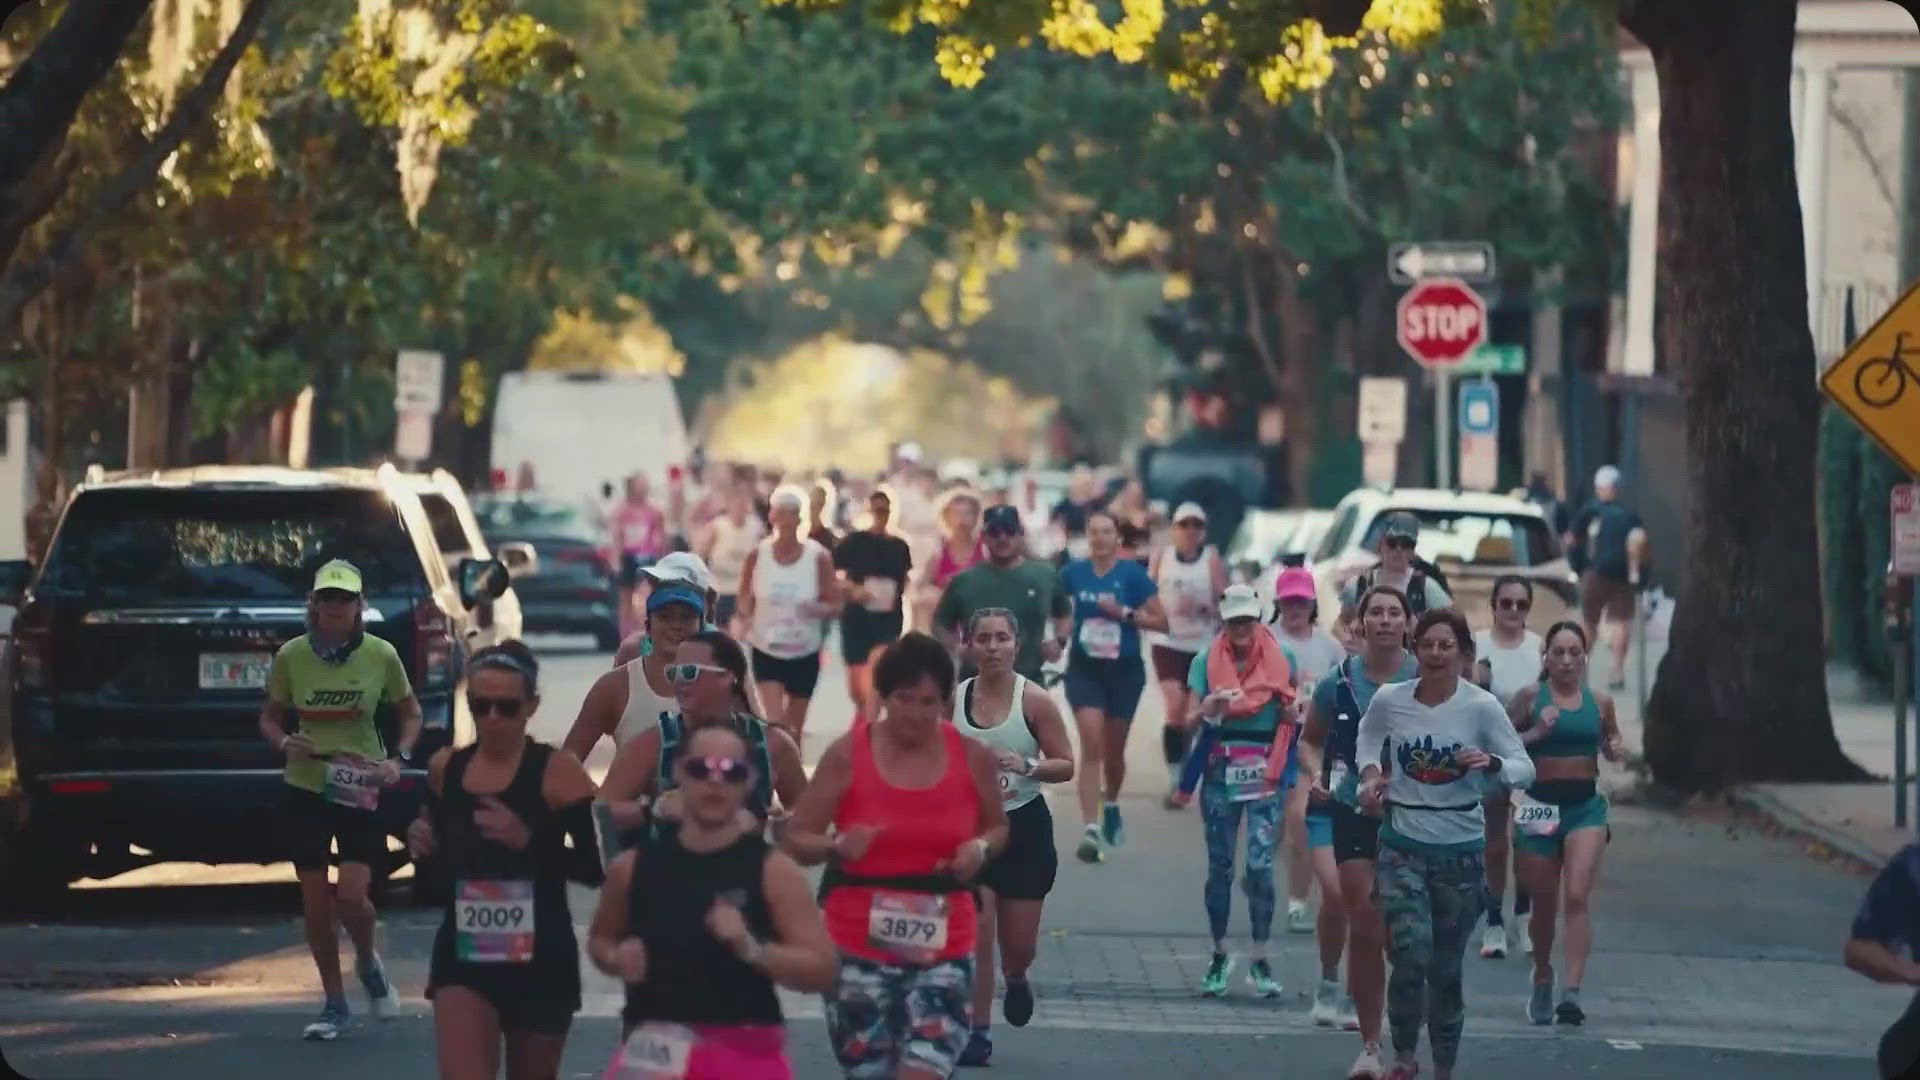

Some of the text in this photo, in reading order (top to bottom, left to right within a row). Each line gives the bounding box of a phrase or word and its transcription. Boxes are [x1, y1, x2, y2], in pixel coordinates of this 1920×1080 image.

[1406, 304, 1478, 342] STOP
[1520, 807, 1553, 820] 2399
[464, 906, 524, 929] 2009
[879, 917, 936, 942] 3879
